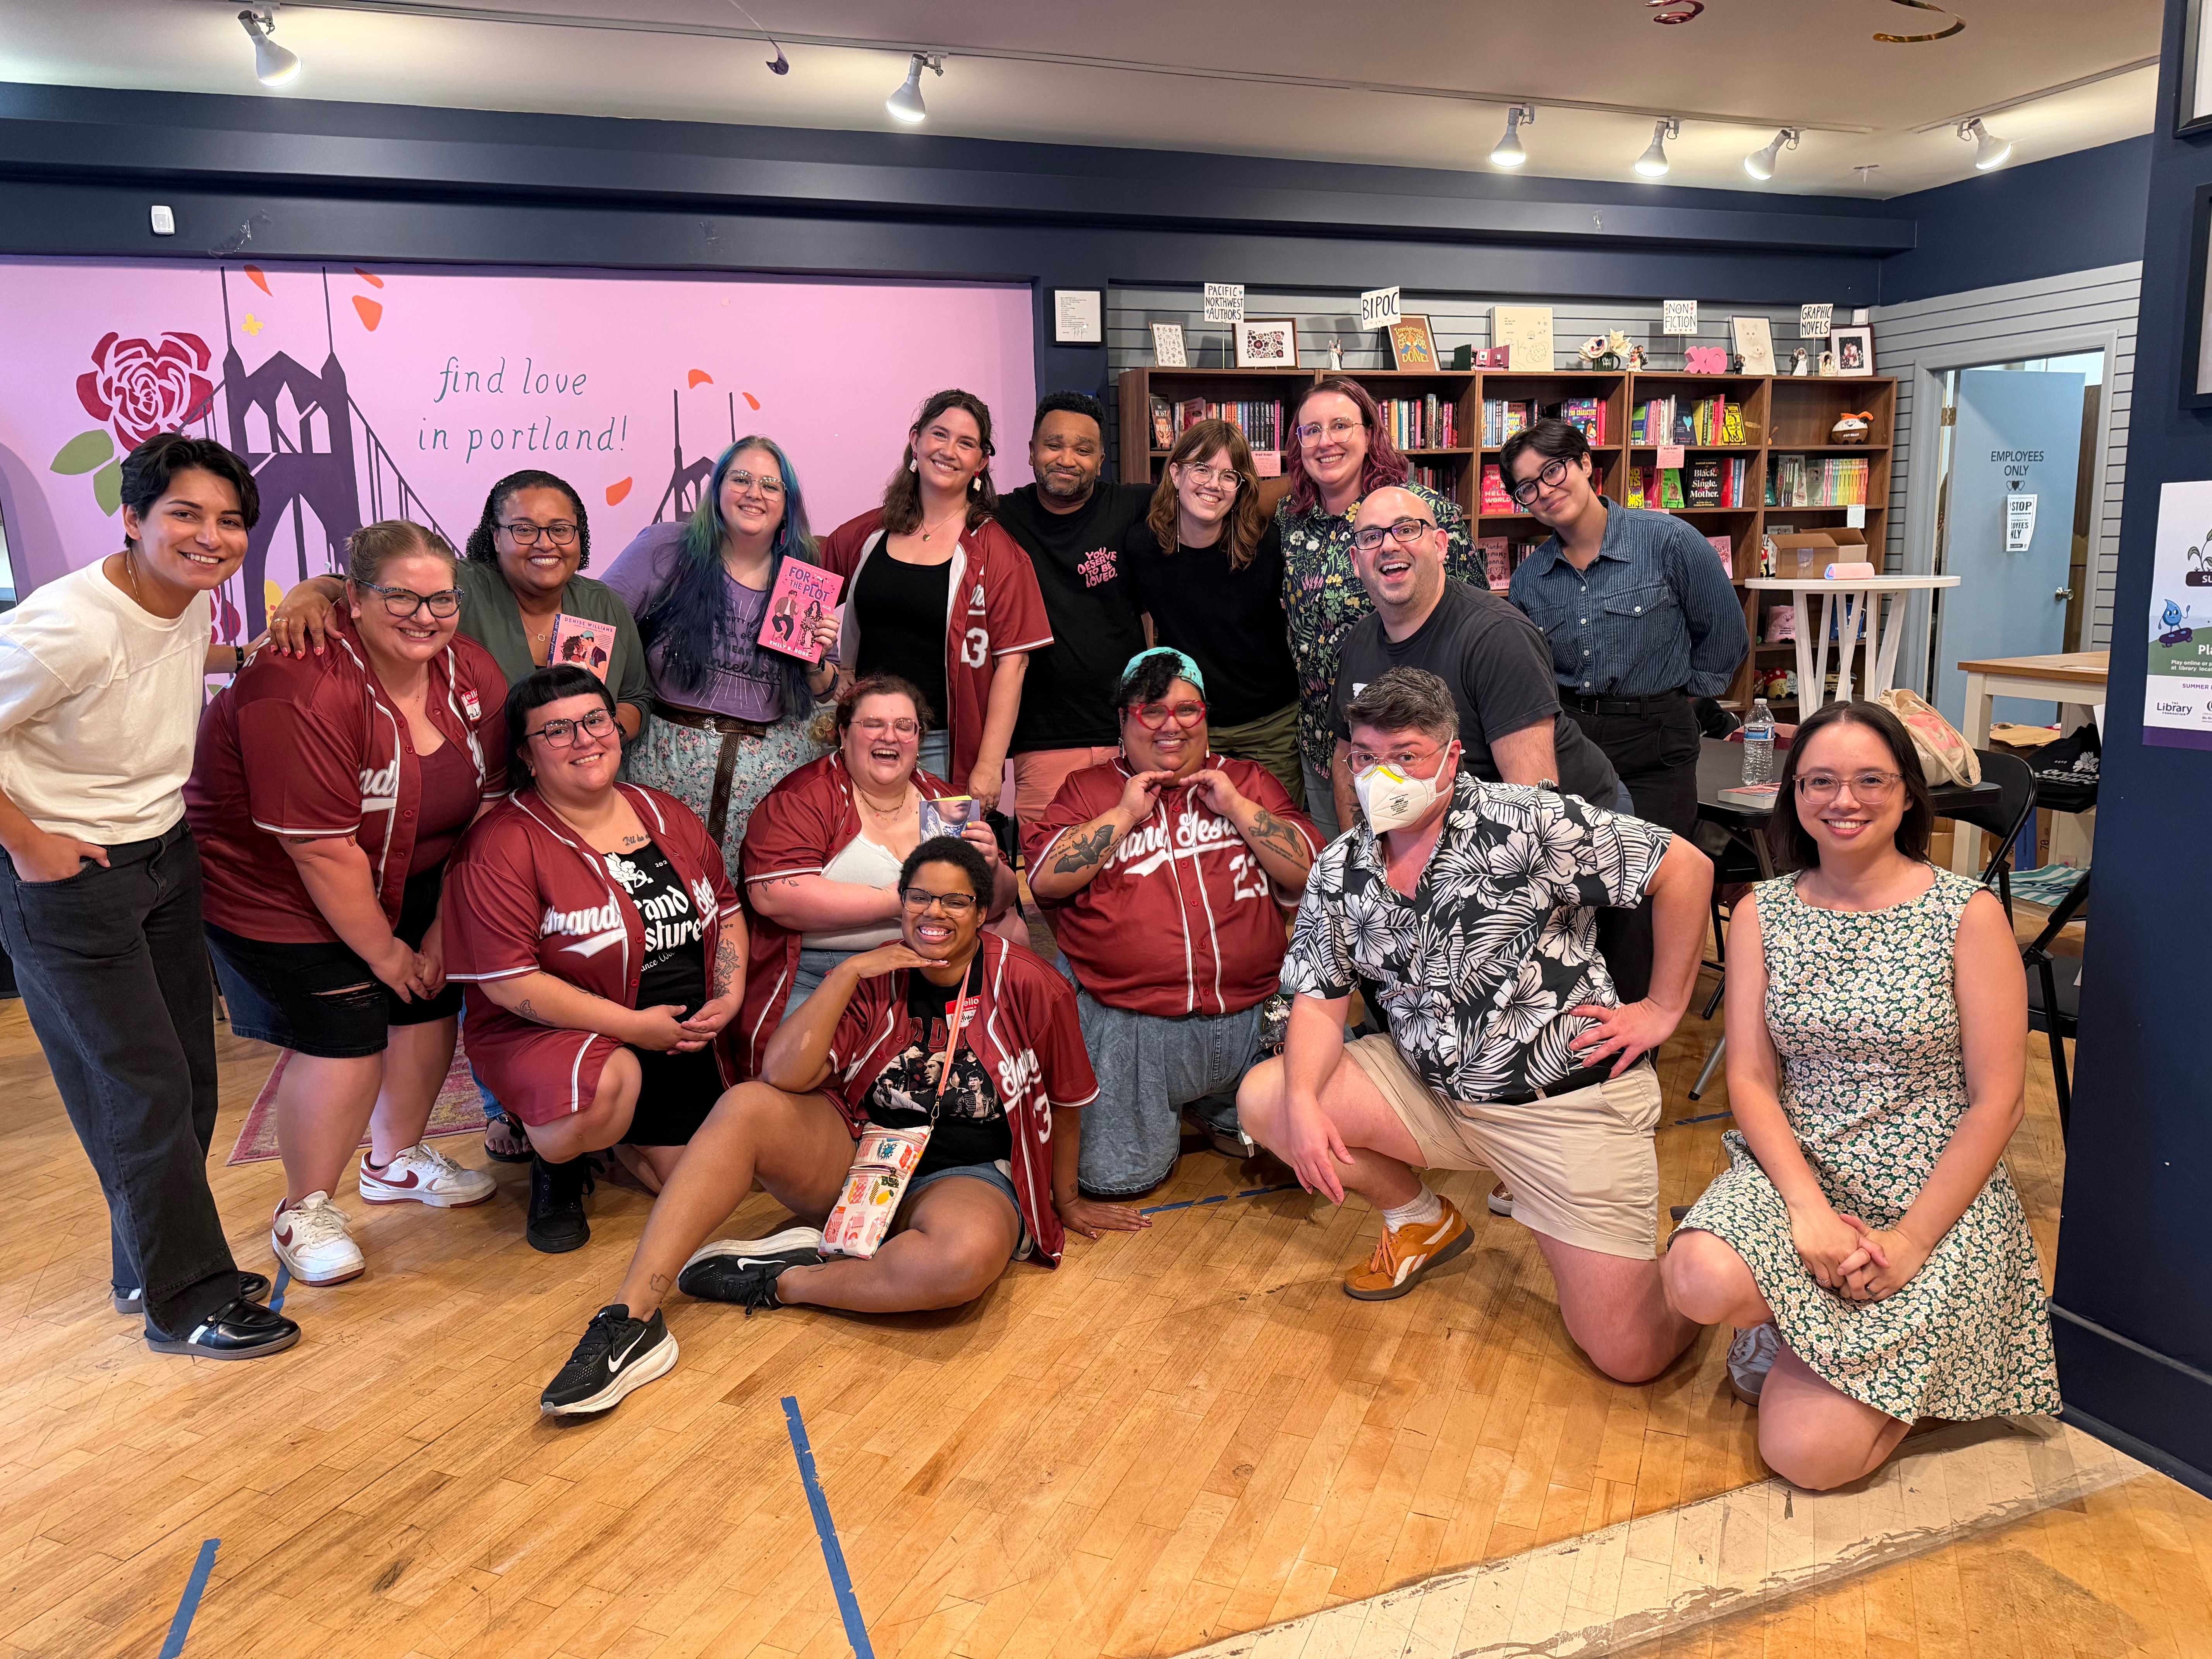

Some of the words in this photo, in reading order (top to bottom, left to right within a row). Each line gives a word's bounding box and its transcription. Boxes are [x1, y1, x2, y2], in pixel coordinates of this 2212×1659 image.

[1208, 285, 1237, 297] PACIFIC
[1205, 297, 1243, 308] NORTHWEST
[1362, 292, 1398, 320] BIPOC
[1669, 302, 1688, 314] NON
[1208, 307, 1241, 320] AUTHORS
[1802, 306, 1832, 320] GRAPHIC
[1665, 315, 1696, 328] FICTION
[1801, 320, 1829, 336] NOVELS
[1398, 336, 1407, 349] GET
[1415, 337, 1427, 349] JOB
[1402, 349, 1429, 363] DONE!
[1684, 346, 1728, 374] XO
[434, 356, 505, 403] find
[522, 357, 587, 395] love
[419, 417, 448, 450] in
[466, 415, 627, 464] portland!
[1990, 451, 2044, 462] EMPLOYEES
[2004, 465, 2029, 476] ONLY
[1692, 479, 1717, 488] Single.
[1690, 490, 1719, 498] Mother.
[2011, 501, 2032, 511] STOP
[1085, 547, 1106, 560] YOU
[1078, 551, 1117, 574] DESERVE
[1087, 567, 1099, 577] TO
[1101, 561, 1113, 572] BE
[789, 566, 811, 583] FOR
[790, 580, 801, 590] THE
[802, 584, 830, 602] PLOT
[565, 617, 585, 626] DENISE
[588, 622, 613, 632] WILLIAMS
[769, 640, 786, 649] EMILY
[793, 649, 809, 657] ROSE
[2157, 702, 2193, 715] Library
[2040, 840, 2049, 851] 70
[964, 998, 979, 1006] ello
